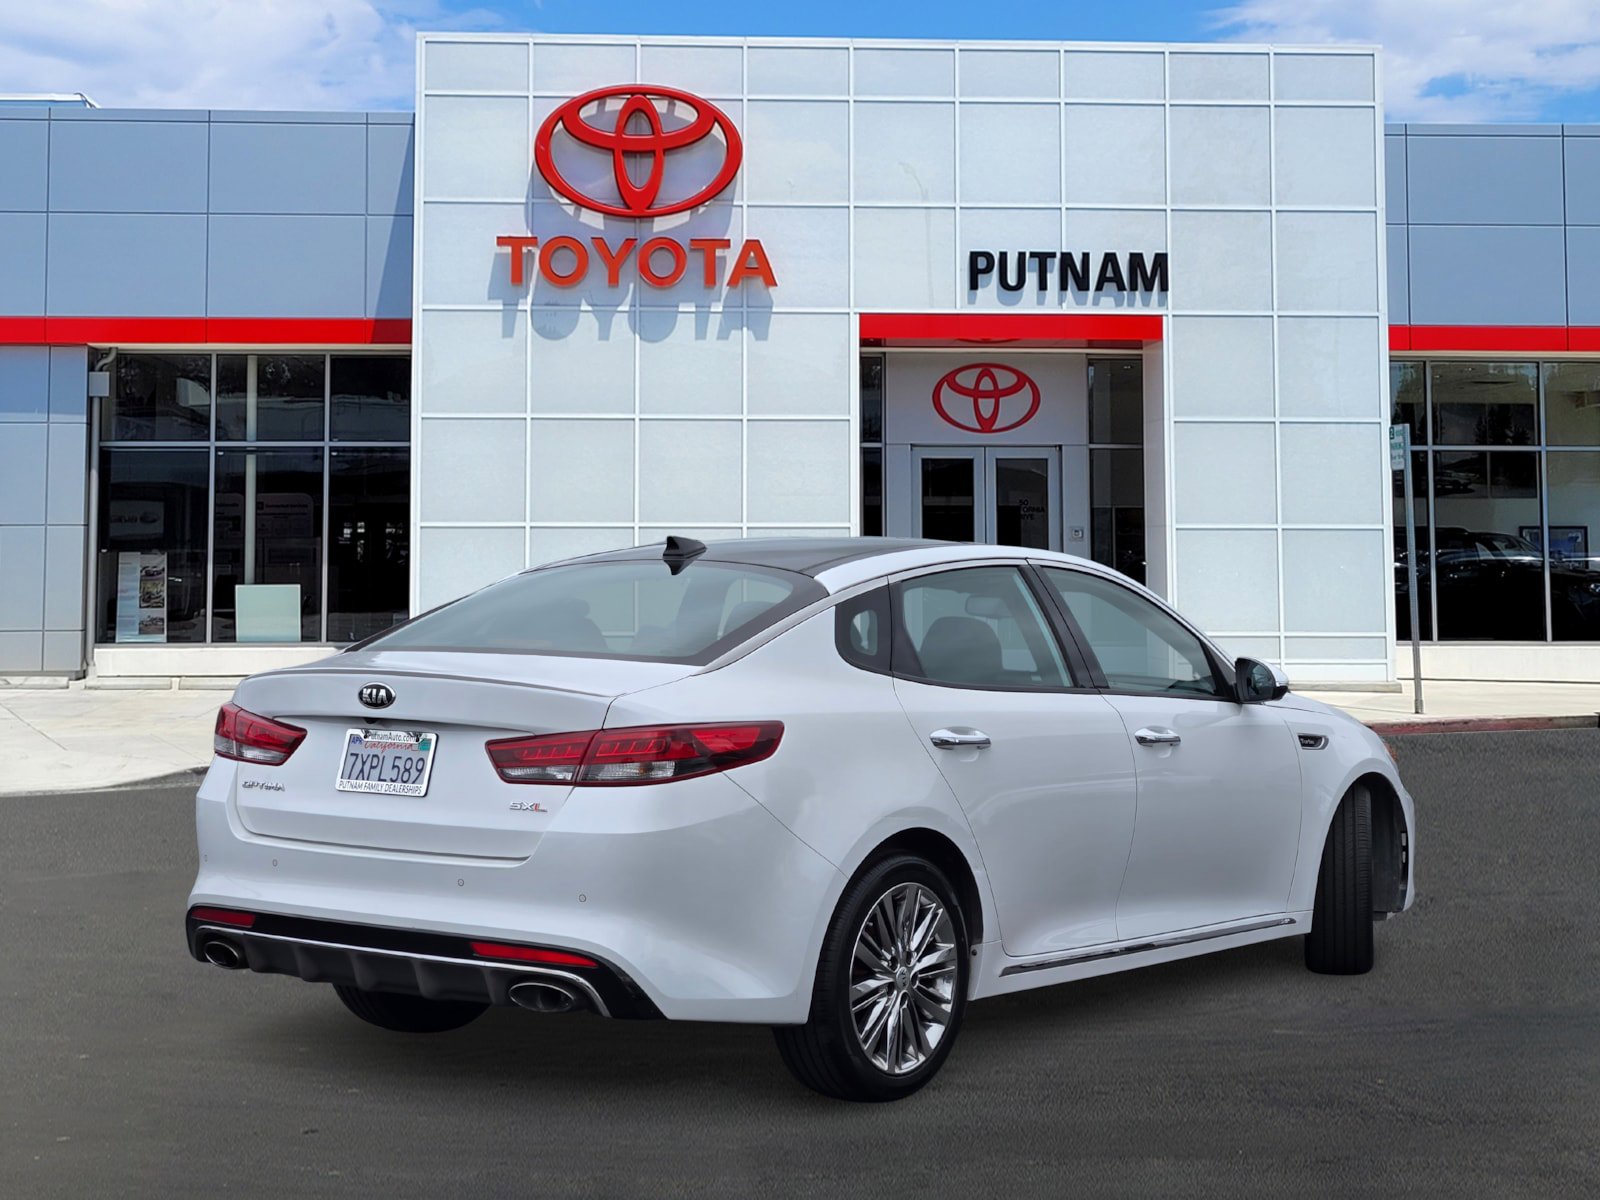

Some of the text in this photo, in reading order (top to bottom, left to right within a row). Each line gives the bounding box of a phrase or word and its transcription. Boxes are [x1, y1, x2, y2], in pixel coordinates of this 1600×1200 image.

[496, 236, 778, 287] TOYOTA
[969, 251, 1169, 292] PUTNAM
[362, 688, 389, 704] KIA
[348, 753, 425, 784] 7XPL589
[338, 780, 423, 795] PUTNAM FAMILY DEALERSHIPS
[508, 801, 548, 813] SXL
